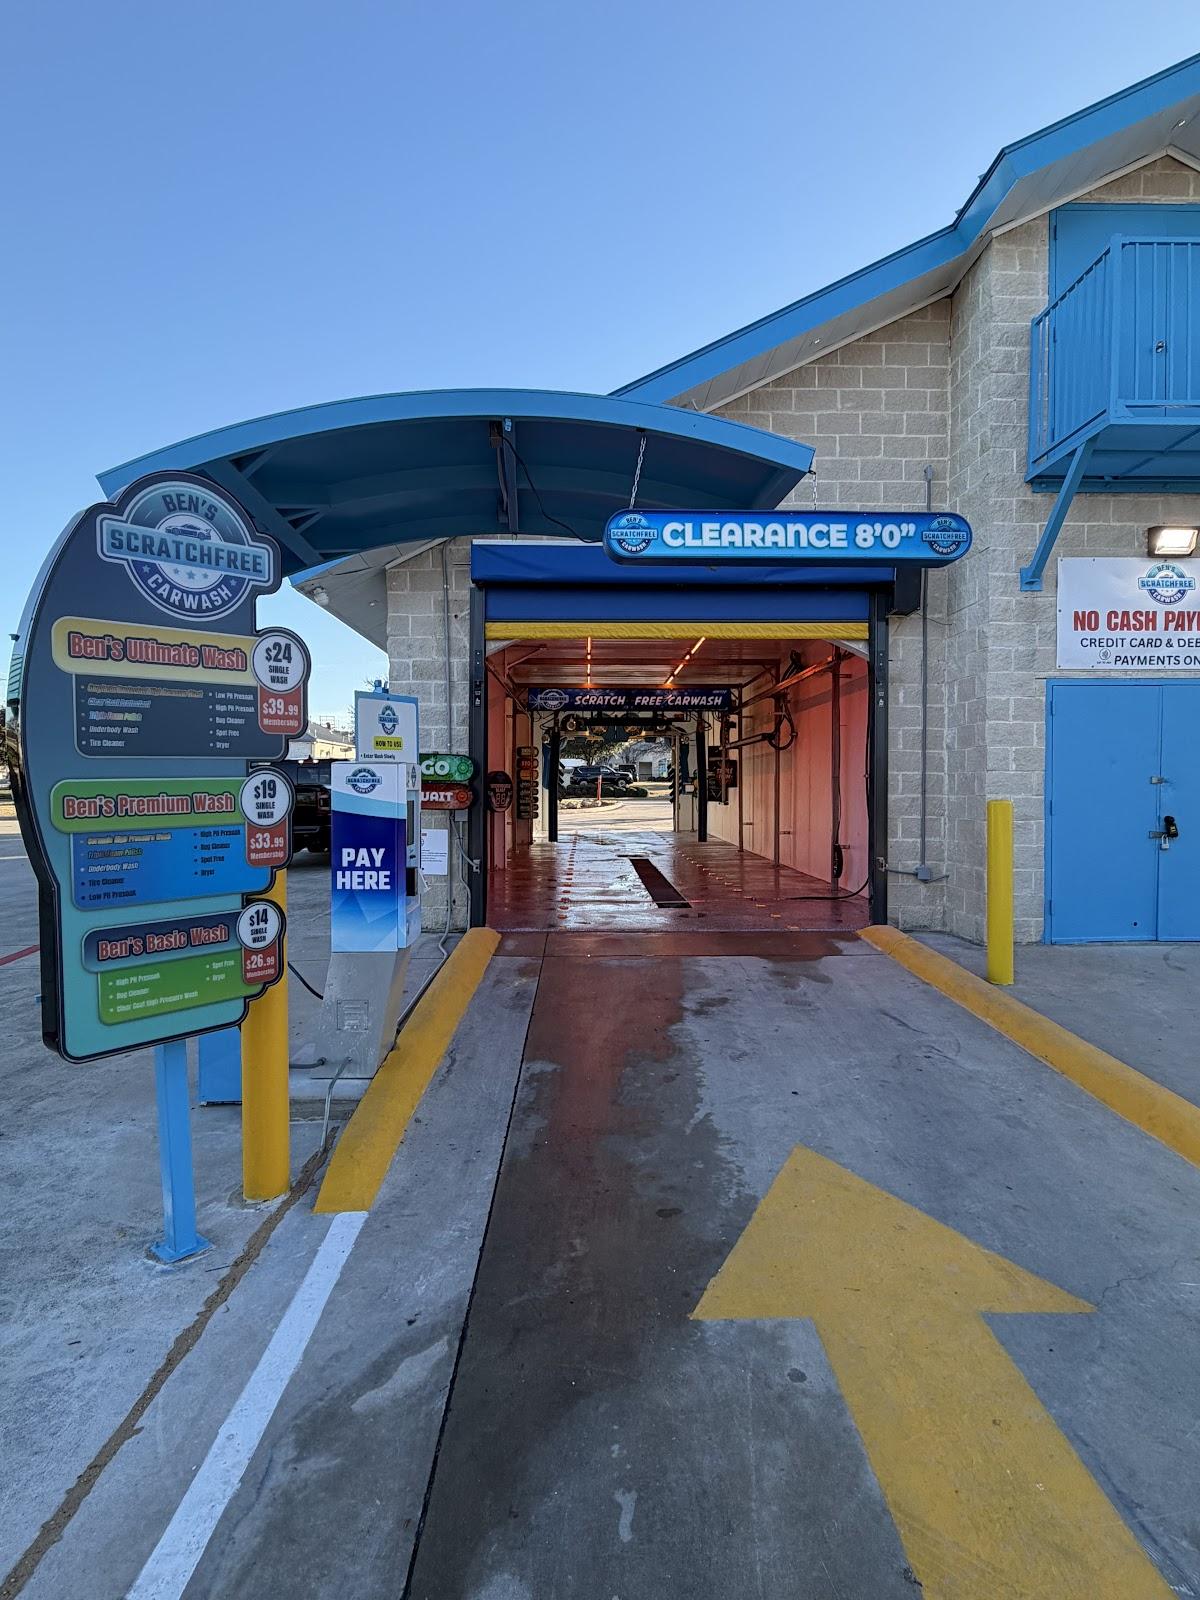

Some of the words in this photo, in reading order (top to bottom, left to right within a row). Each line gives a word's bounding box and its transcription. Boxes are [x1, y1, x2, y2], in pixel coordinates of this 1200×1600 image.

[162, 493, 218, 522] BEN'S
[611, 530, 657, 538] SCRATCHFREE
[662, 522, 848, 548] CLEARANCE
[110, 528, 263, 574] SCRATCHFREE
[1140, 580, 1194, 588] SCRATCHFREE
[147, 574, 233, 610] CARWASH
[1153, 592, 1182, 603] CARWASH
[1073, 610, 1100, 631] NO
[1106, 610, 1157, 631] CASH
[1080, 637, 1126, 648] CREDIT
[1129, 637, 1162, 648] CARD
[1165, 637, 1174, 648] &
[69, 633, 124, 660] Ben's
[126, 638, 199, 666] Ultimate
[202, 646, 246, 670] Wash
[265, 641, 293, 664] $24
[1114, 655, 1180, 665] PAYMENTS
[268, 665, 290, 674] SINGLE
[270, 676, 288, 684] WASH
[262, 698, 299, 715] $39.99
[574, 695, 626, 705] SCRATCH
[634, 696, 662, 706] FREE
[667, 695, 722, 706] CARWASH
[226, 717, 245, 725] Cleaner
[263, 718, 299, 727] Membership
[89, 725, 121, 734] Underbody
[122, 726, 138, 734] Wash
[90, 739, 101, 747] Tire
[102, 739, 125, 747] Cleaner
[421, 760, 450, 776] GO
[254, 779, 277, 799] $19
[64, 796, 116, 819] Ben's
[118, 794, 191, 815] Premium
[192, 792, 235, 812] Wash
[255, 801, 276, 810] SINGLE
[257, 811, 274, 819] WASH
[250, 832, 284, 849] $33.99
[250, 850, 284, 860] Membership
[341, 847, 386, 867] PAY
[336, 870, 391, 890] HERE
[249, 908, 269, 927] $14
[250, 926, 268, 936] SINGLE
[98, 936, 143, 960] Ben's
[146, 929, 188, 952] Basic
[190, 924, 229, 945] Wash
[251, 935, 267, 944] WASH
[246, 954, 275, 970] $26.99
